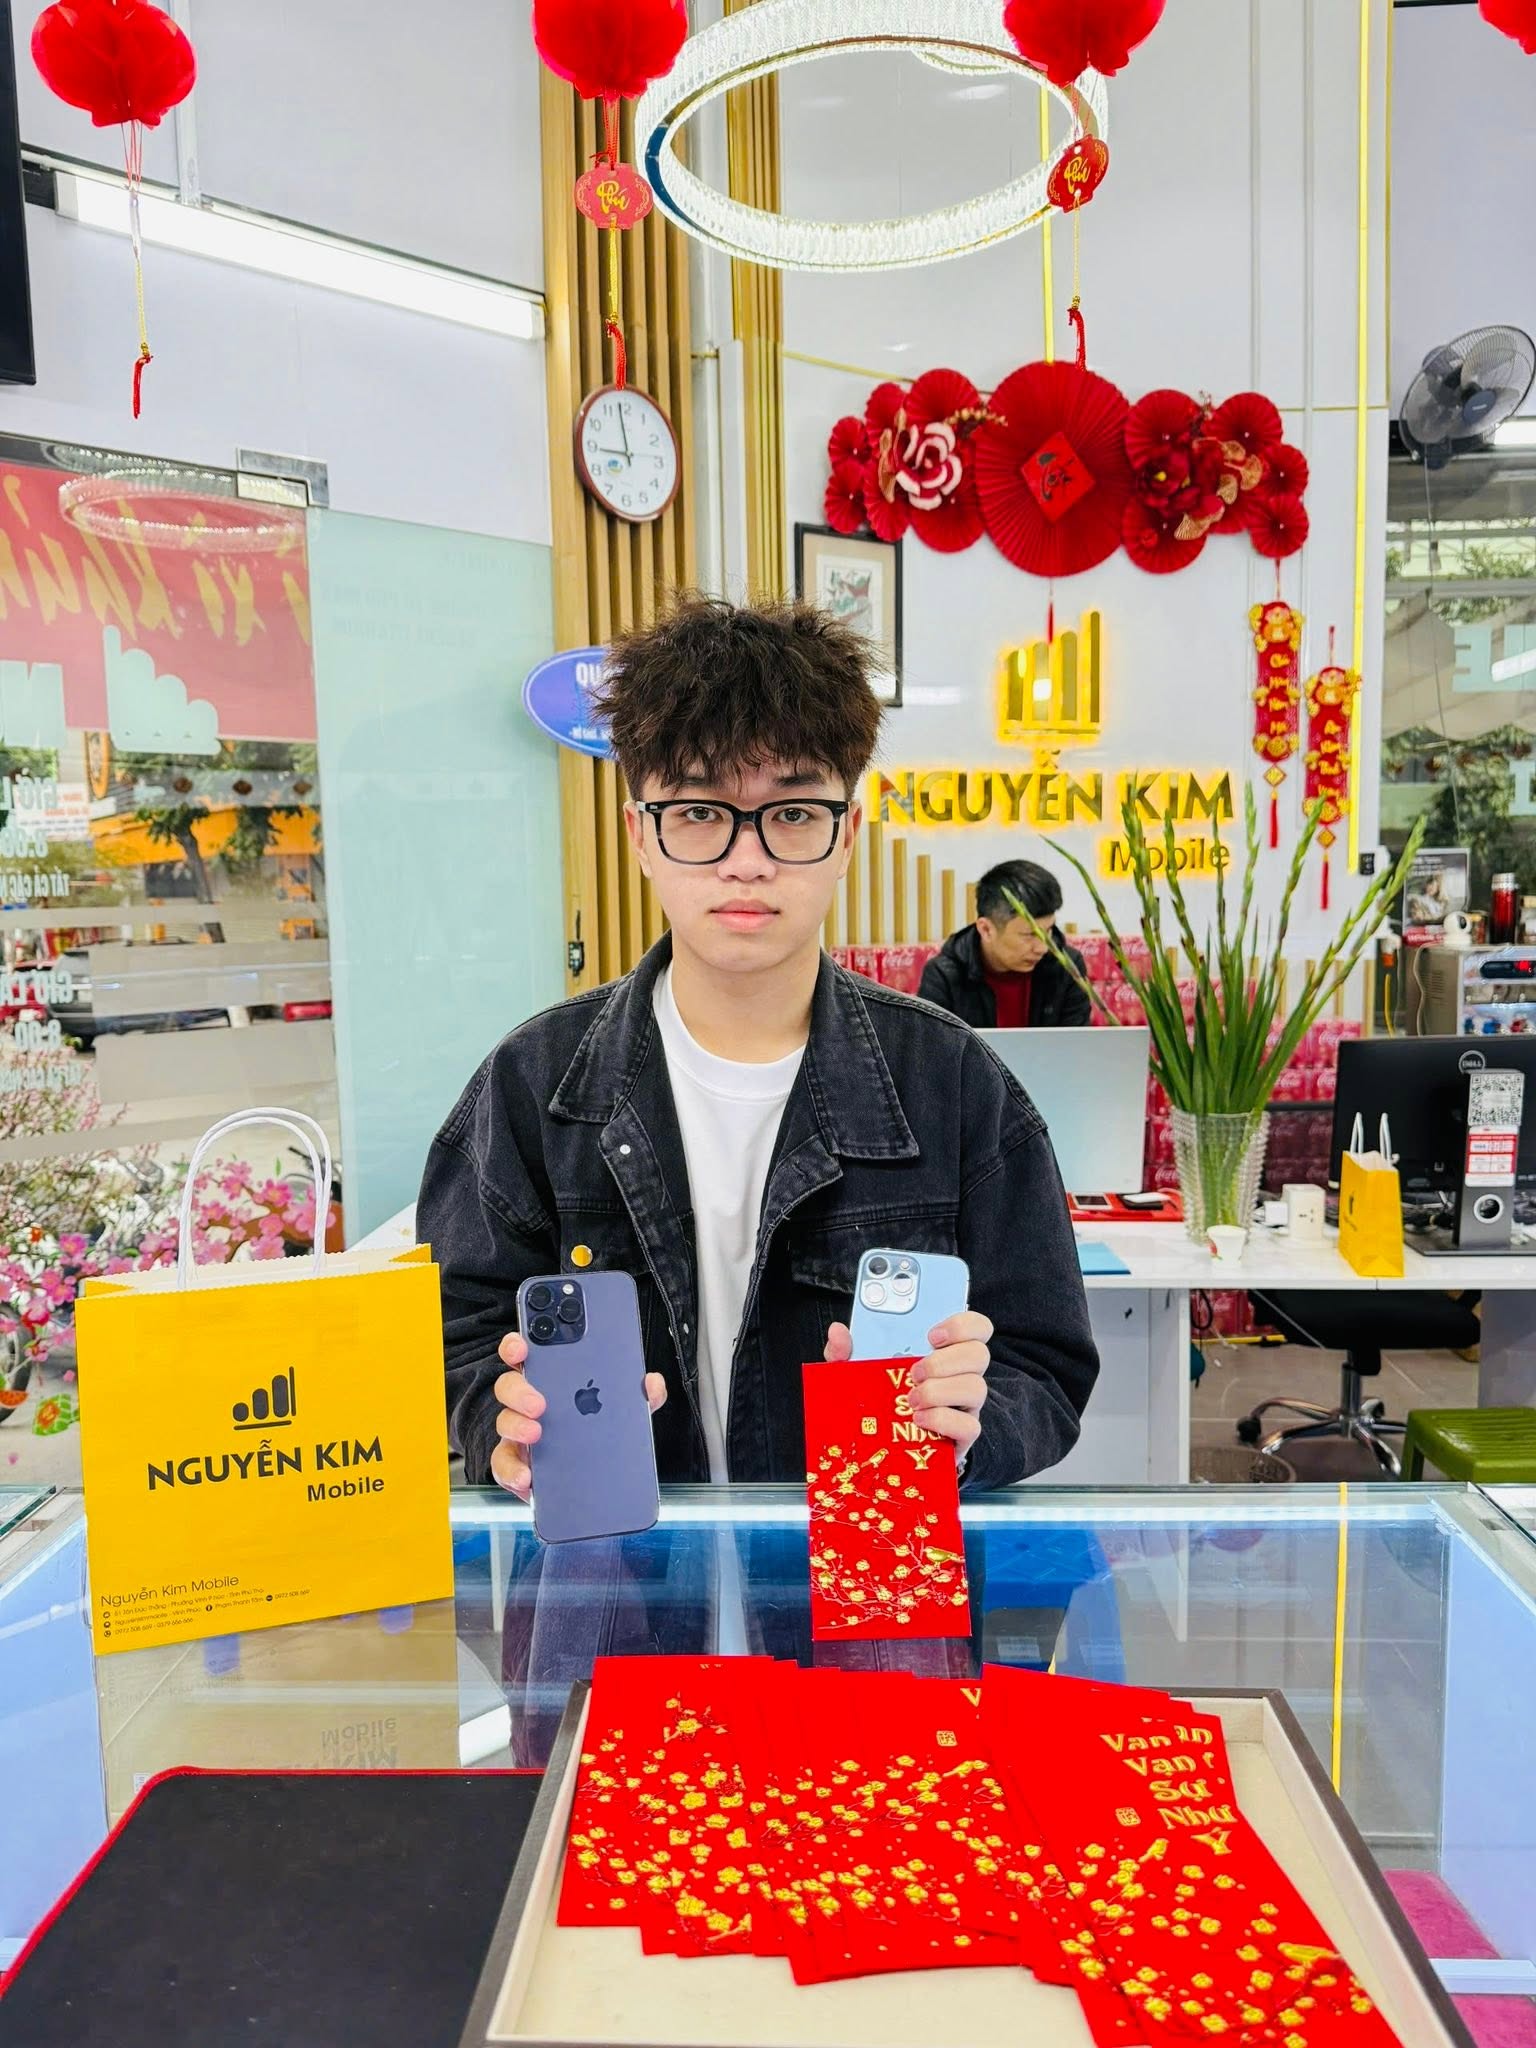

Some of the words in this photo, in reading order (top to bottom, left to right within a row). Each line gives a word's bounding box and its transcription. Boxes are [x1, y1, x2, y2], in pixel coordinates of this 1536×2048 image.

[586, 439, 598, 453] 9
[591, 463, 602, 476] 8
[604, 483, 614, 495] 7
[621, 494, 632, 508] 6
[879, 749, 1103, 823] NGUYỄN
[1123, 771, 1234, 820] KIM
[148, 1439, 303, 1491] NGUYỄN
[315, 1436, 384, 1471] KIM
[905, 1444, 937, 1470] Ý
[307, 1477, 385, 1502] Mobile
[101, 1587, 158, 1607] Nguyễn
[162, 1584, 188, 1598] Kim
[191, 1576, 239, 1592] Mobile
[1123, 1755, 1197, 1776] Vạn
[1149, 1778, 1213, 1802] Sự
[1157, 1804, 1238, 1830] Như
[1190, 1826, 1232, 1855] Ý
